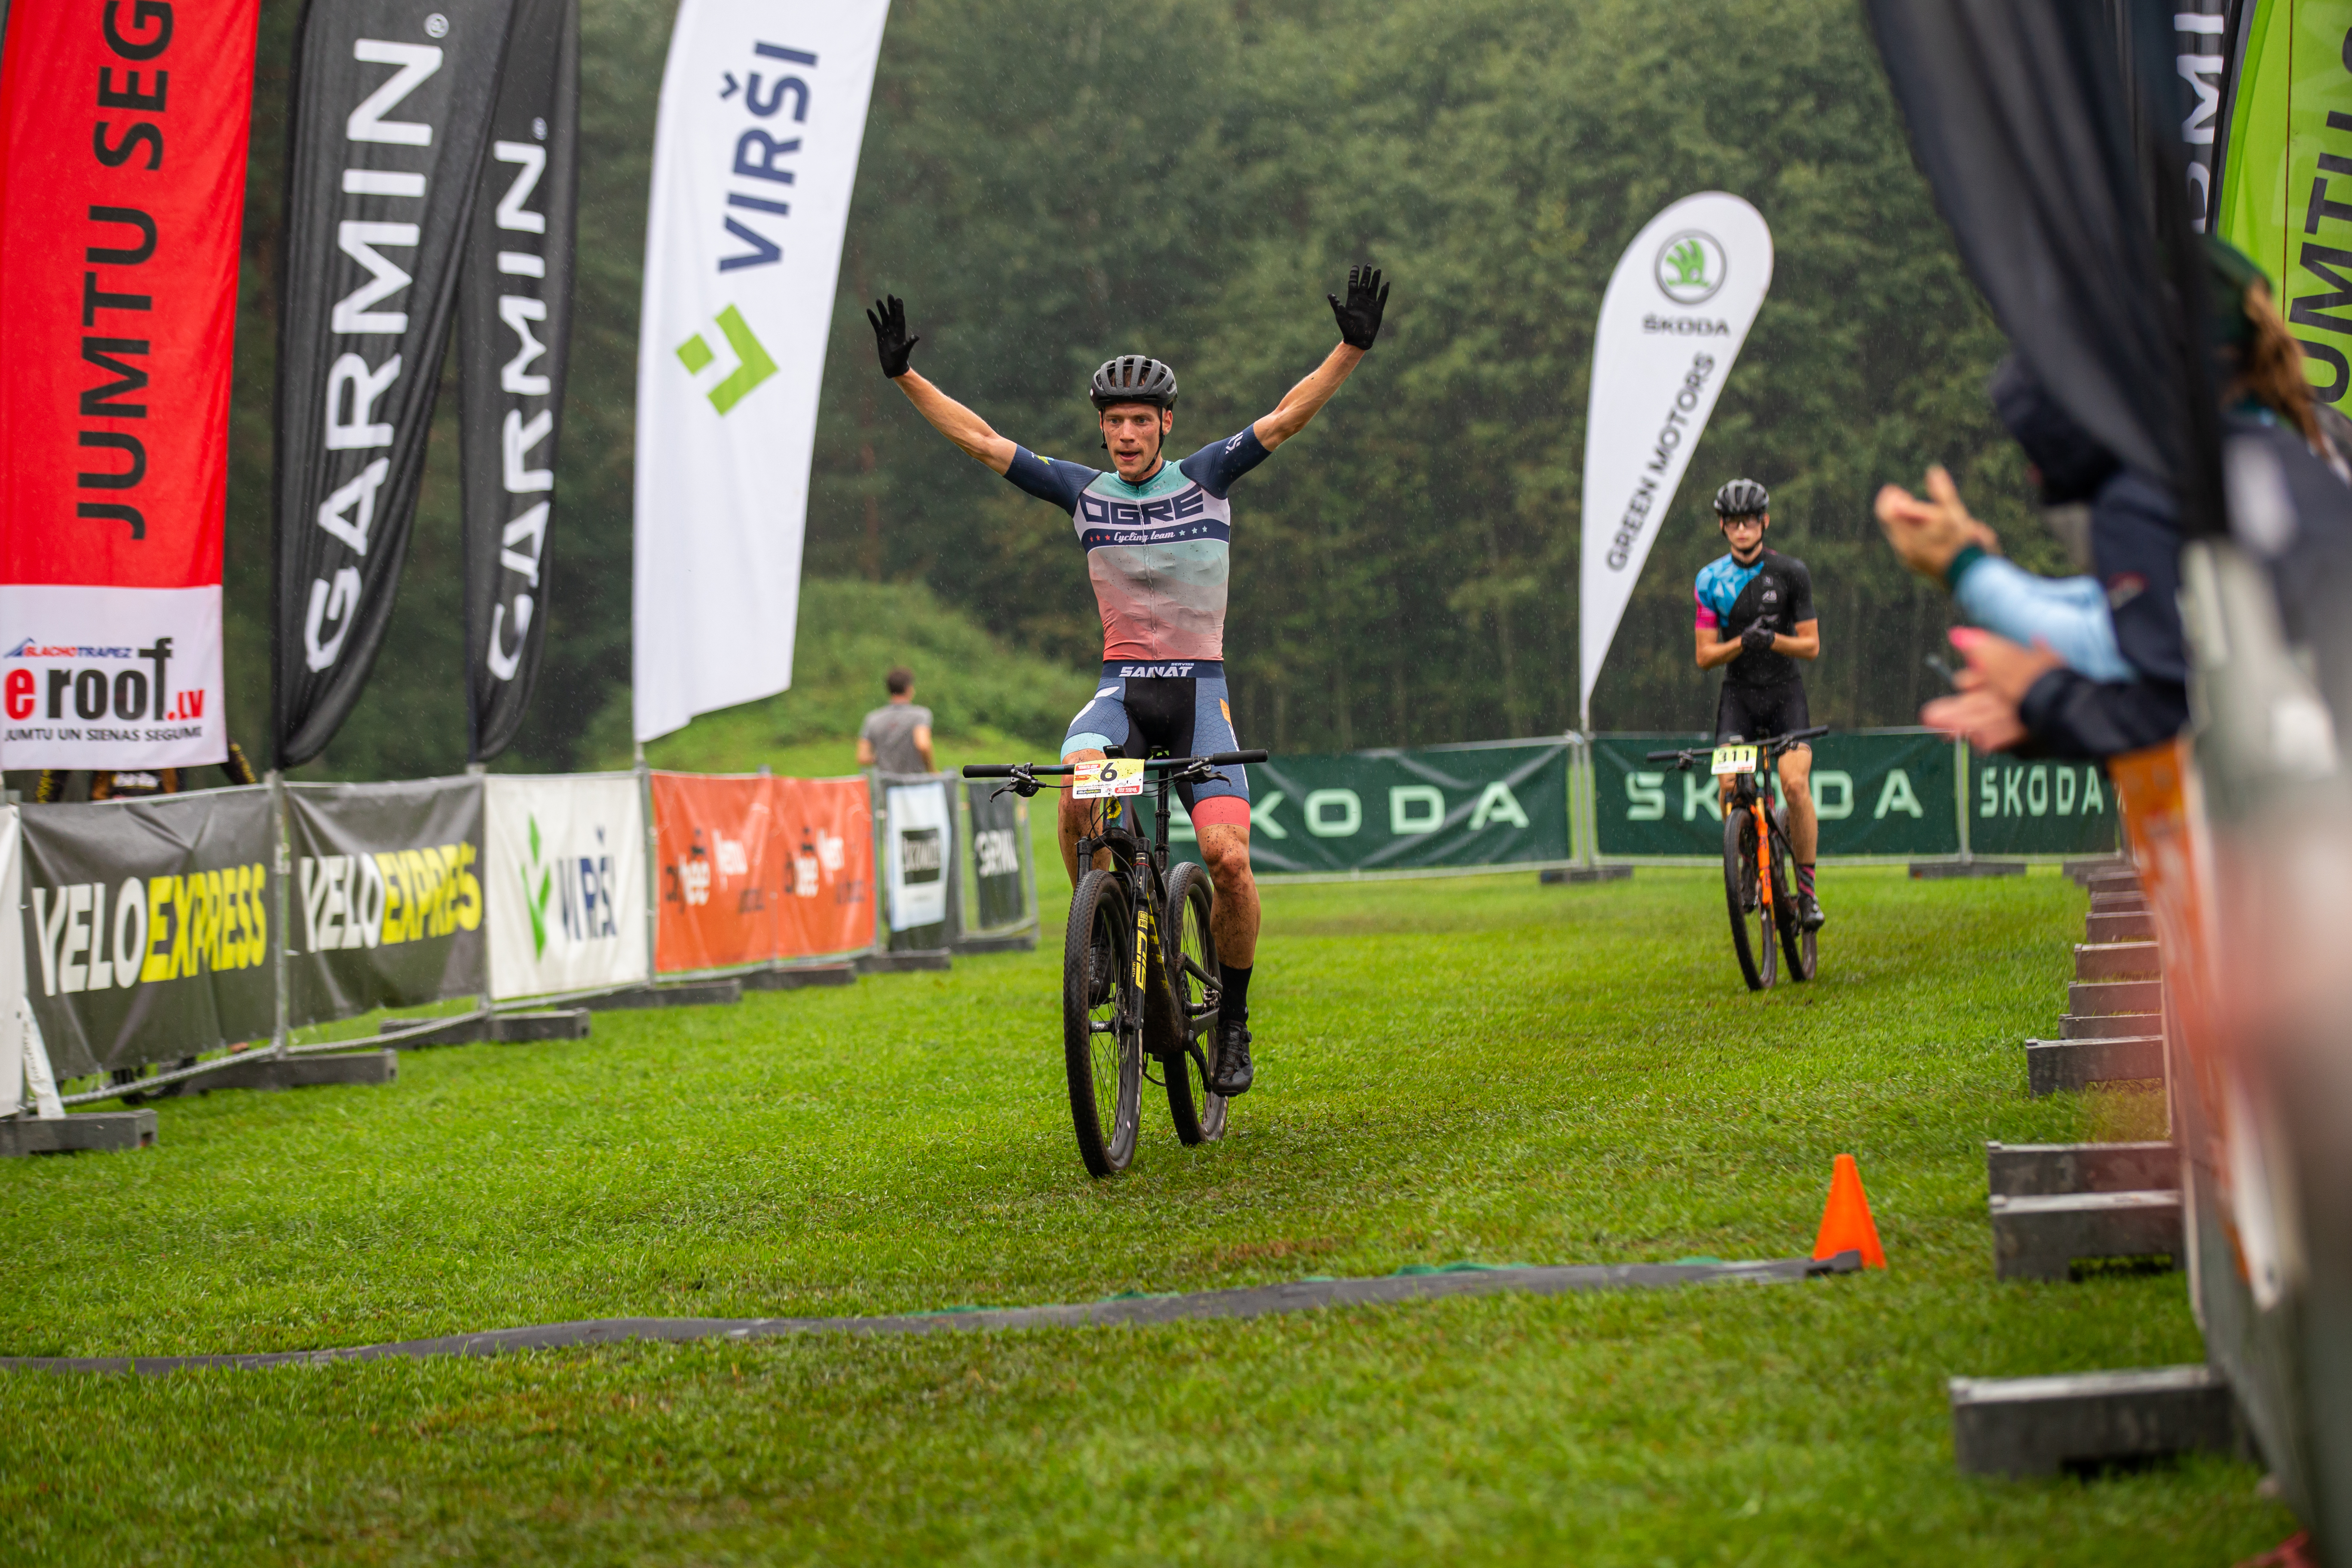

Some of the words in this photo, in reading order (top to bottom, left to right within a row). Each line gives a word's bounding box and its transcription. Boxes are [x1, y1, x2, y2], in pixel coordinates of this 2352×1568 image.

[92, 0, 174, 172] SEG
[717, 40, 819, 274] VIRŠI
[77, 205, 159, 540] JUMTU
[1079, 483, 1204, 525] OGRE
[1605, 477, 1658, 573] GREEN
[1651, 352, 1715, 476] MOTORS
[1114, 532, 1149, 542] Cycling
[1150, 530, 1175, 540] team
[1118, 666, 1193, 677] SANAT
[5, 727, 53, 742] JUMTU
[58, 727, 81, 741] UN
[1100, 762, 1118, 782] 6
[32, 862, 267, 997] VELOEXPRESS
